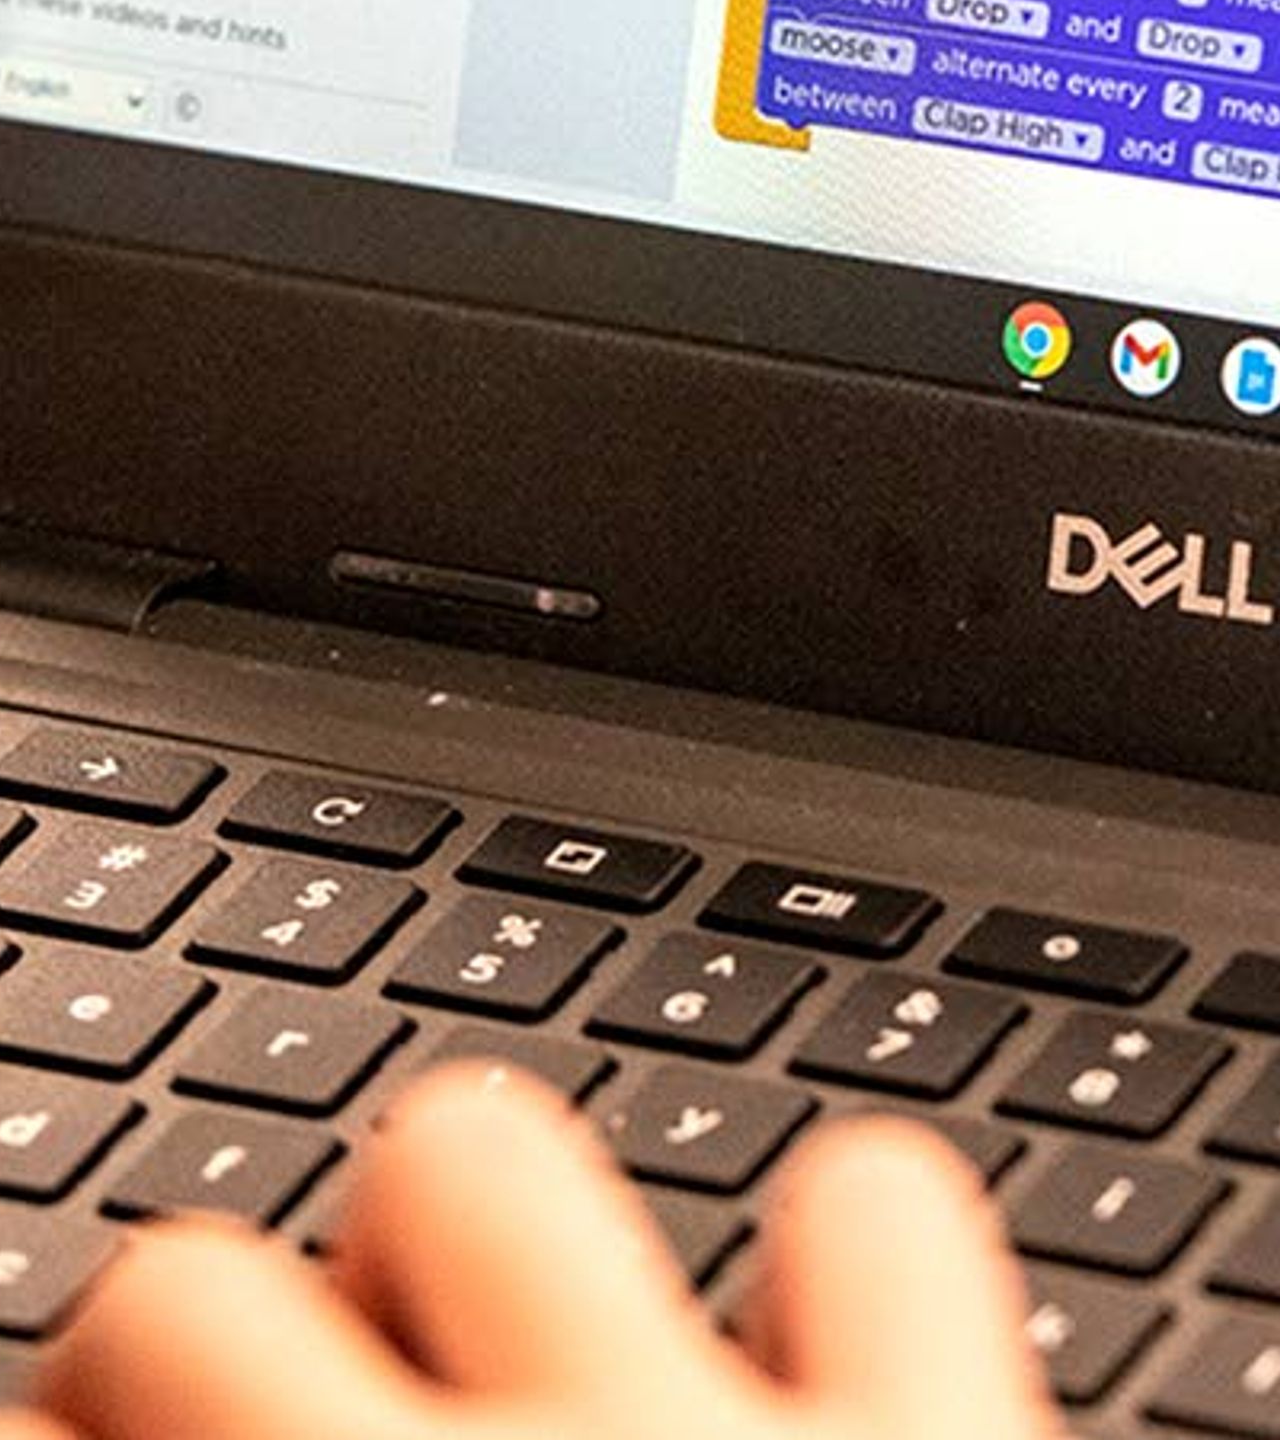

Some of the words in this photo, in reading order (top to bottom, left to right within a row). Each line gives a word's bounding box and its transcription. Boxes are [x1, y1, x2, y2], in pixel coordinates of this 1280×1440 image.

[91, 1, 169, 34] videos
[175, 13, 222, 41] and
[228, 19, 287, 52] hints
[1066, 12, 1122, 42] and
[1148, 22, 1222, 60] Drop
[5, 71, 73, 100] English
[780, 28, 877, 64] moose
[932, 48, 1060, 91] alternate
[1067, 72, 1147, 108] every
[1173, 88, 1192, 113] 2
[774, 77, 897, 122] between
[924, 103, 989, 140] Clap
[996, 111, 1064, 150] High
[1119, 135, 1177, 165] and
[1202, 148, 1269, 185] Clap
[1046, 511, 1275, 625] DELL
[65, 882, 106, 909] 3
[295, 878, 341, 910] $
[458, 955, 505, 984] 5
